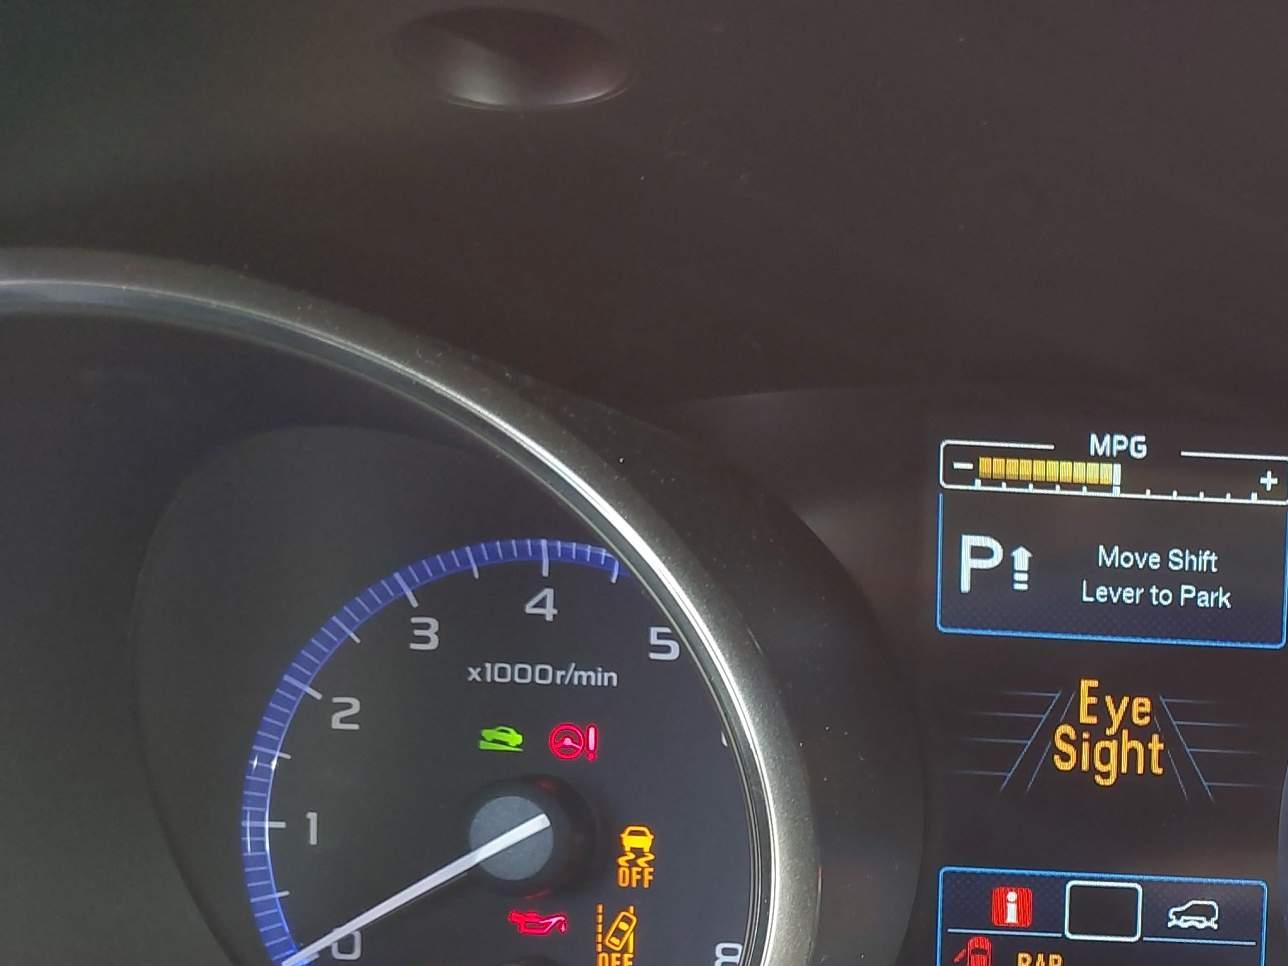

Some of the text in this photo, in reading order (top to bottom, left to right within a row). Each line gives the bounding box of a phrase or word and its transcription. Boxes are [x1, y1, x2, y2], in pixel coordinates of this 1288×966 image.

[1090, 434, 1147, 459] MPG
[960, 535, 1003, 593] P
[1098, 545, 1218, 573] Move Shift
[525, 589, 558, 621] 4
[1082, 580, 1231, 609] Lever to Park
[410, 617, 439, 650] 3
[649, 627, 680, 660] 5
[332, 697, 360, 730] 2
[1079, 679, 1151, 735] Eye
[1053, 725, 1164, 785] Sight
[306, 813, 318, 844] 1
[617, 868, 654, 888] OFF
[331, 928, 362, 961] 0
